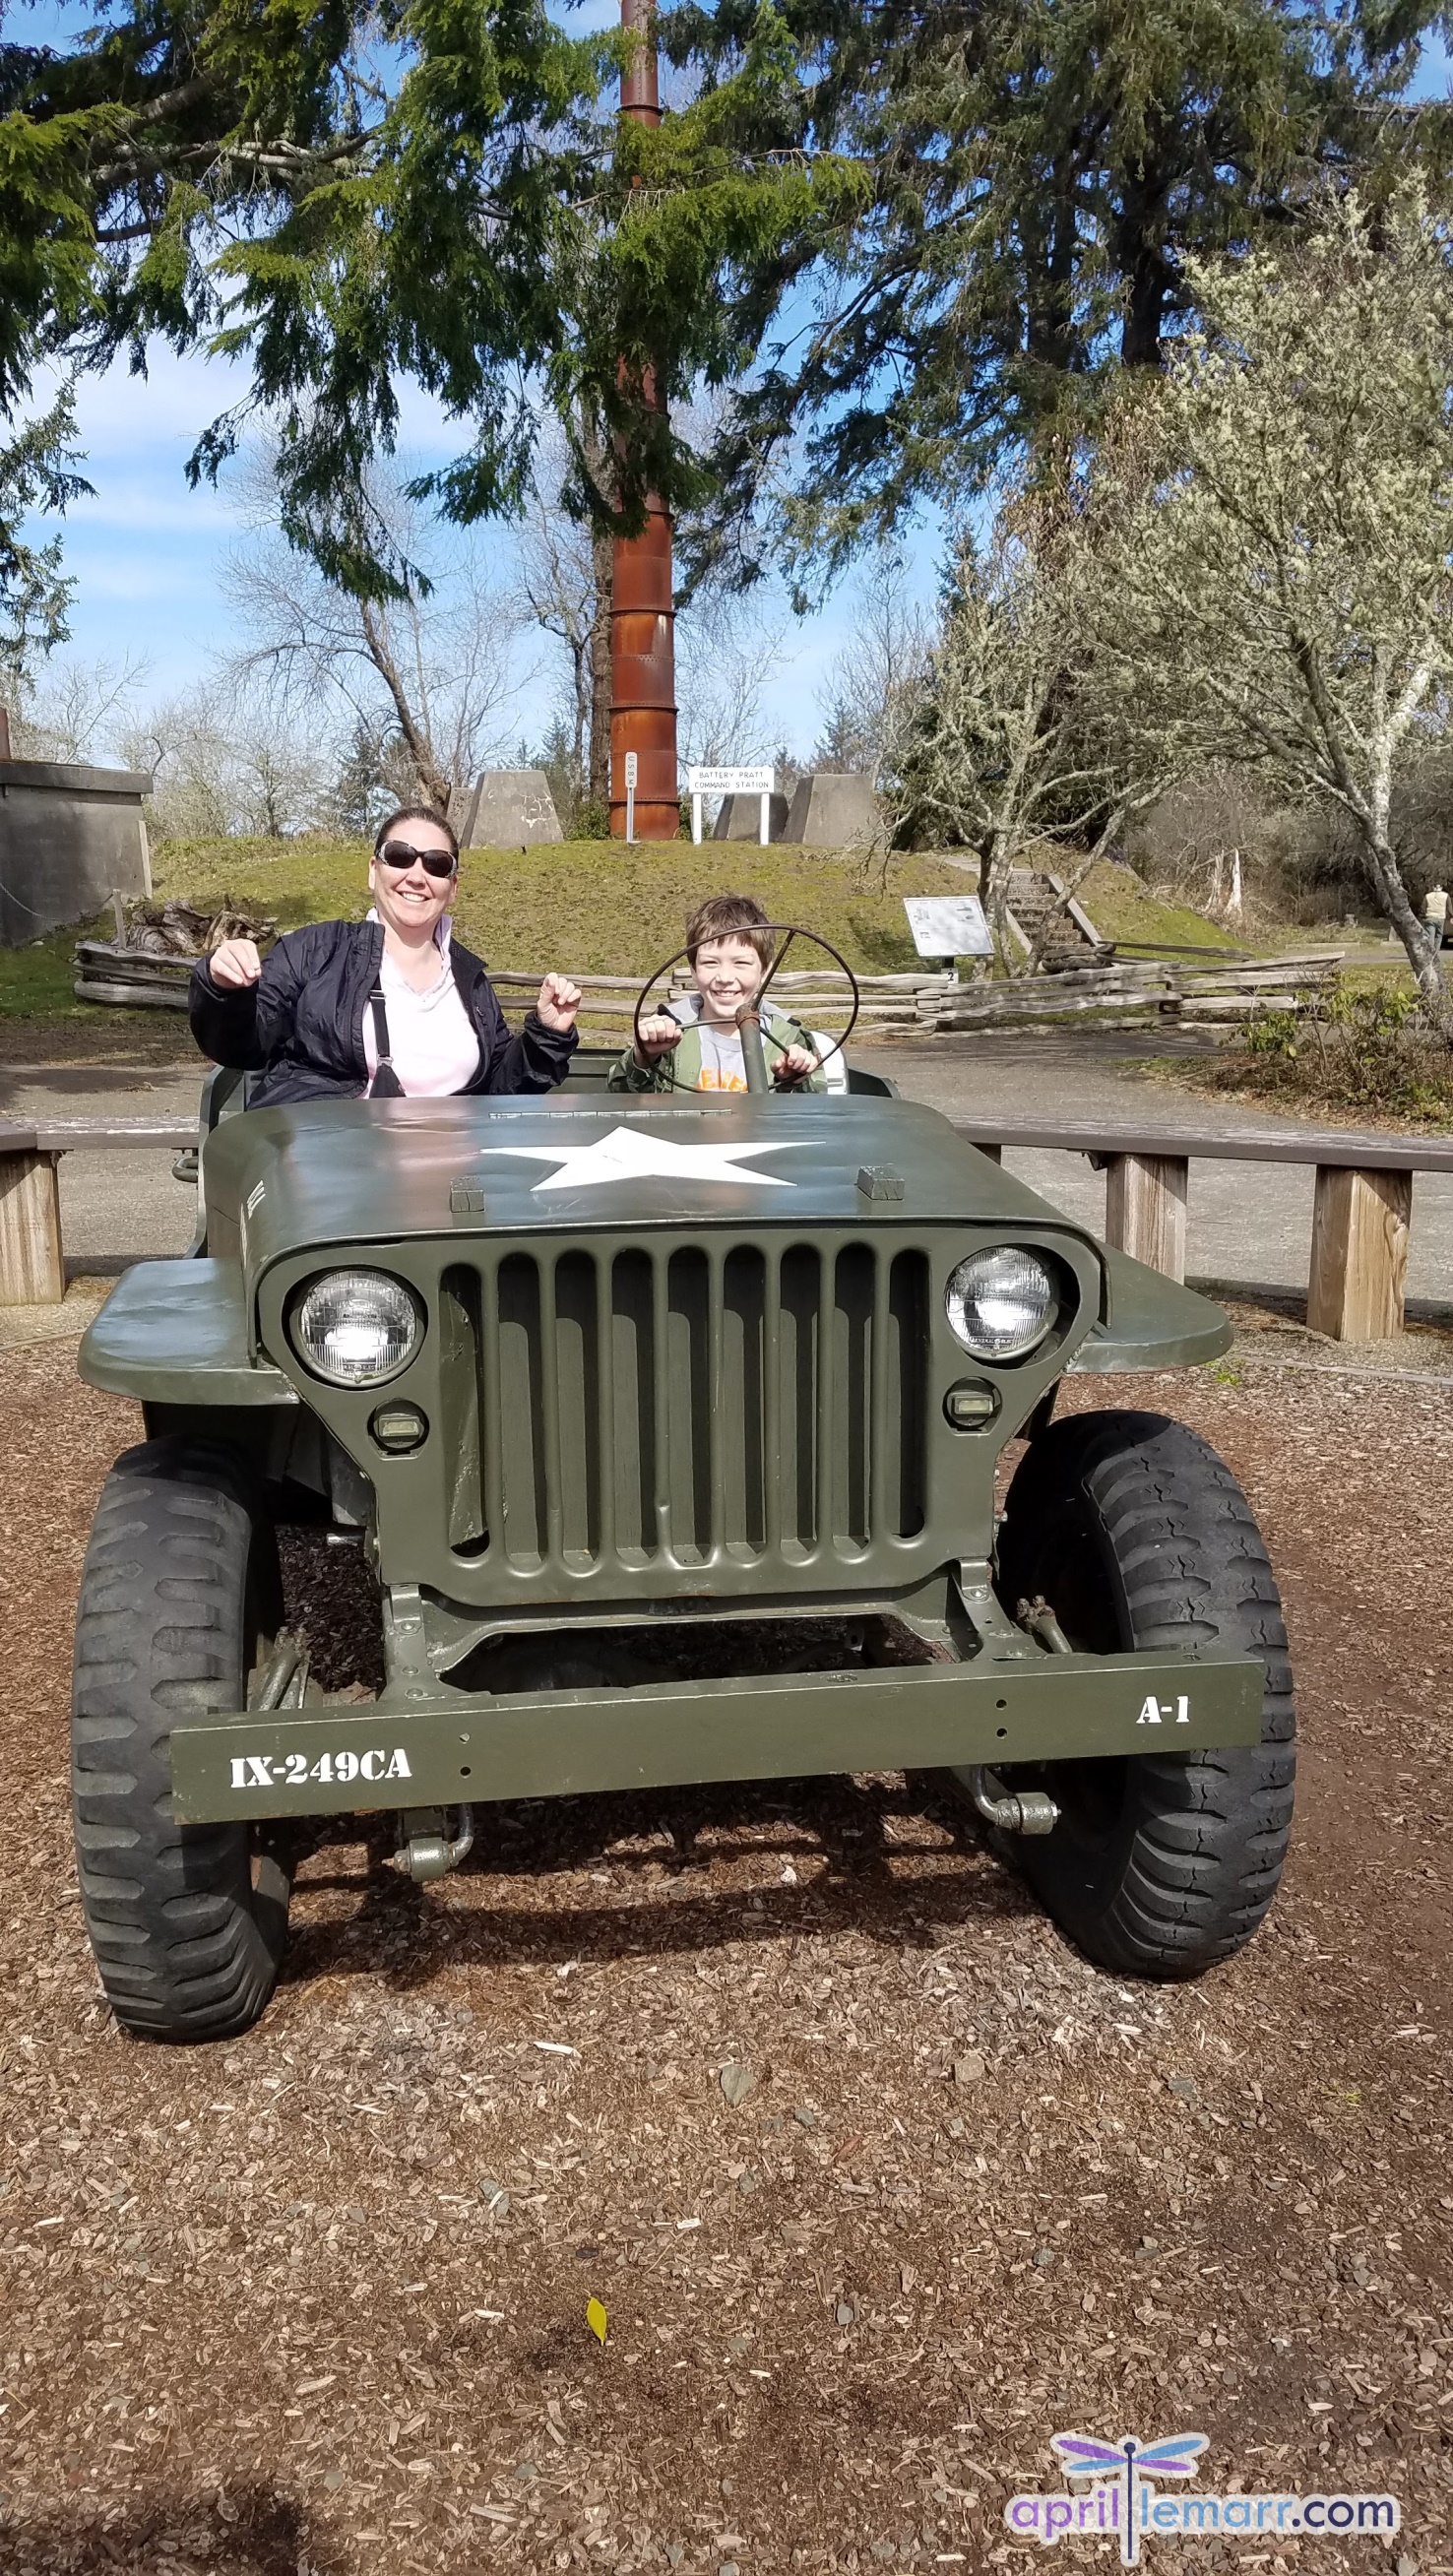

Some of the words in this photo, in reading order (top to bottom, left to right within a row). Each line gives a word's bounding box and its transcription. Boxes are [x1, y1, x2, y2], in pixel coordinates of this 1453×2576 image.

[947, 972, 955, 981] 2
[1135, 1695, 1190, 1725] A-1
[229, 1748, 412, 1789] IX-249CA
